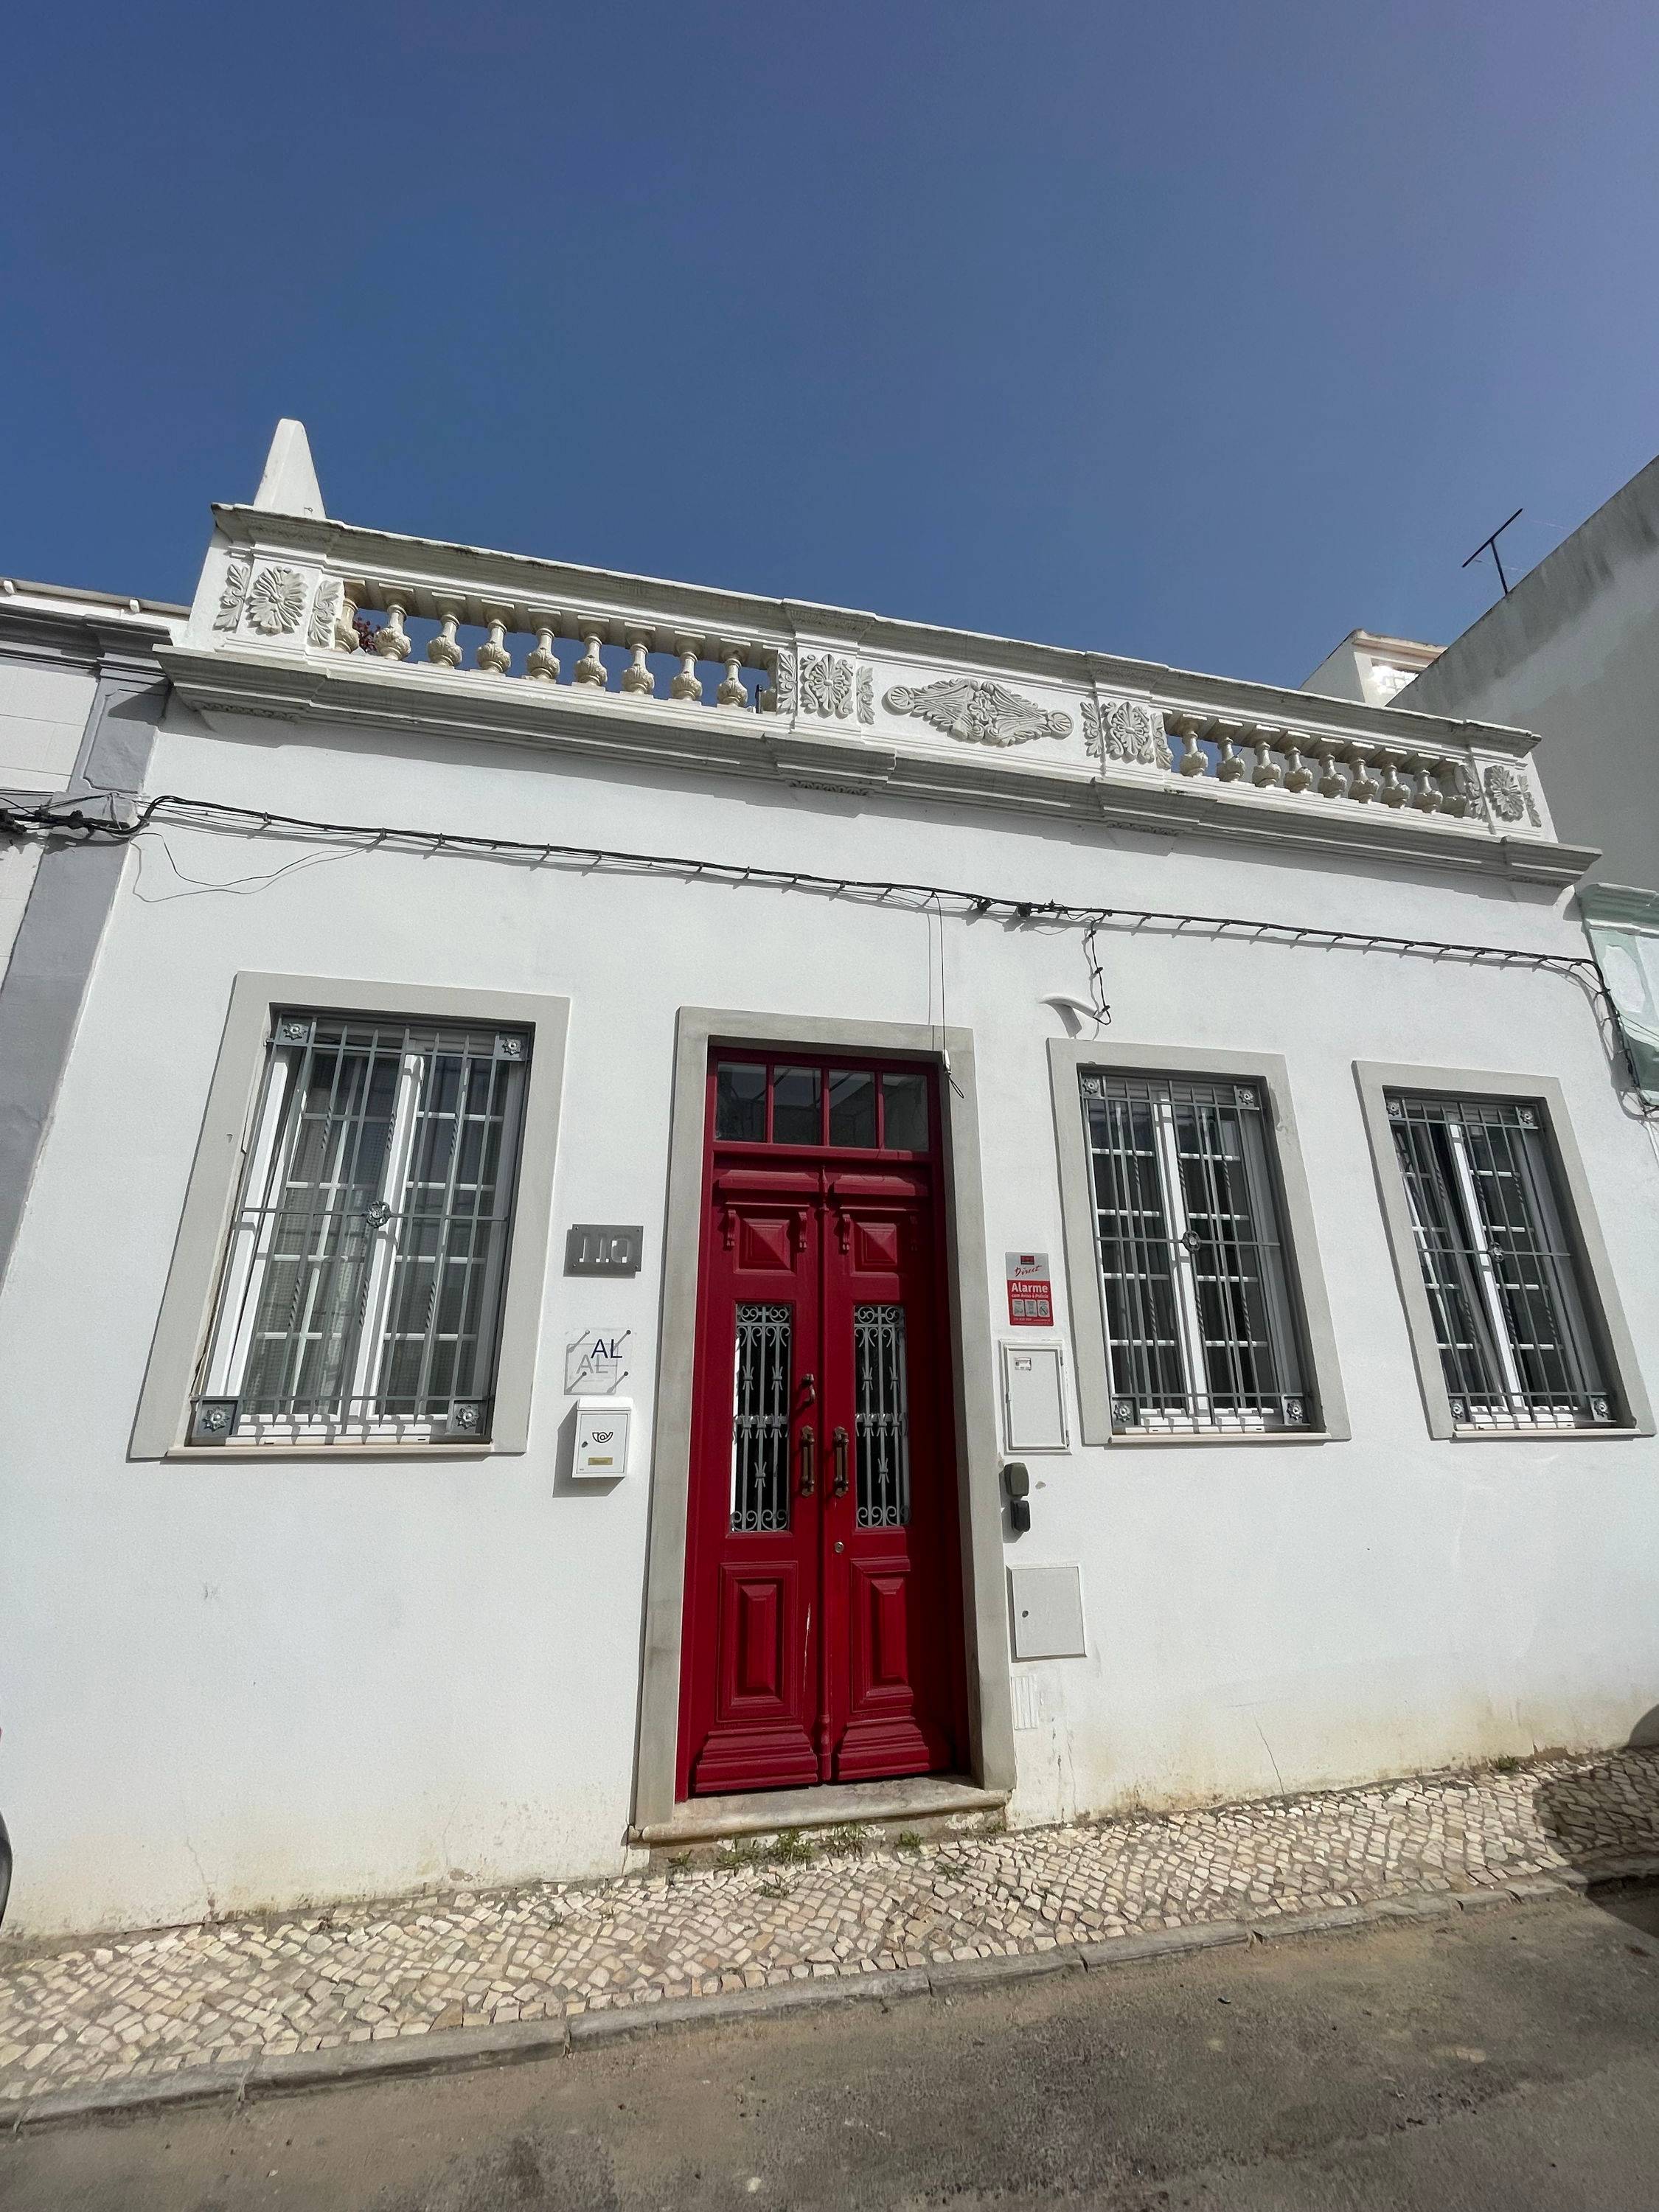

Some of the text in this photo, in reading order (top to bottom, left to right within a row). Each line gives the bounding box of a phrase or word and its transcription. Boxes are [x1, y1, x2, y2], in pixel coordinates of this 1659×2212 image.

[579, 1234, 632, 1263] 110
[1011, 1281, 1048, 1293] Alarme
[591, 1339, 622, 1358] AL
